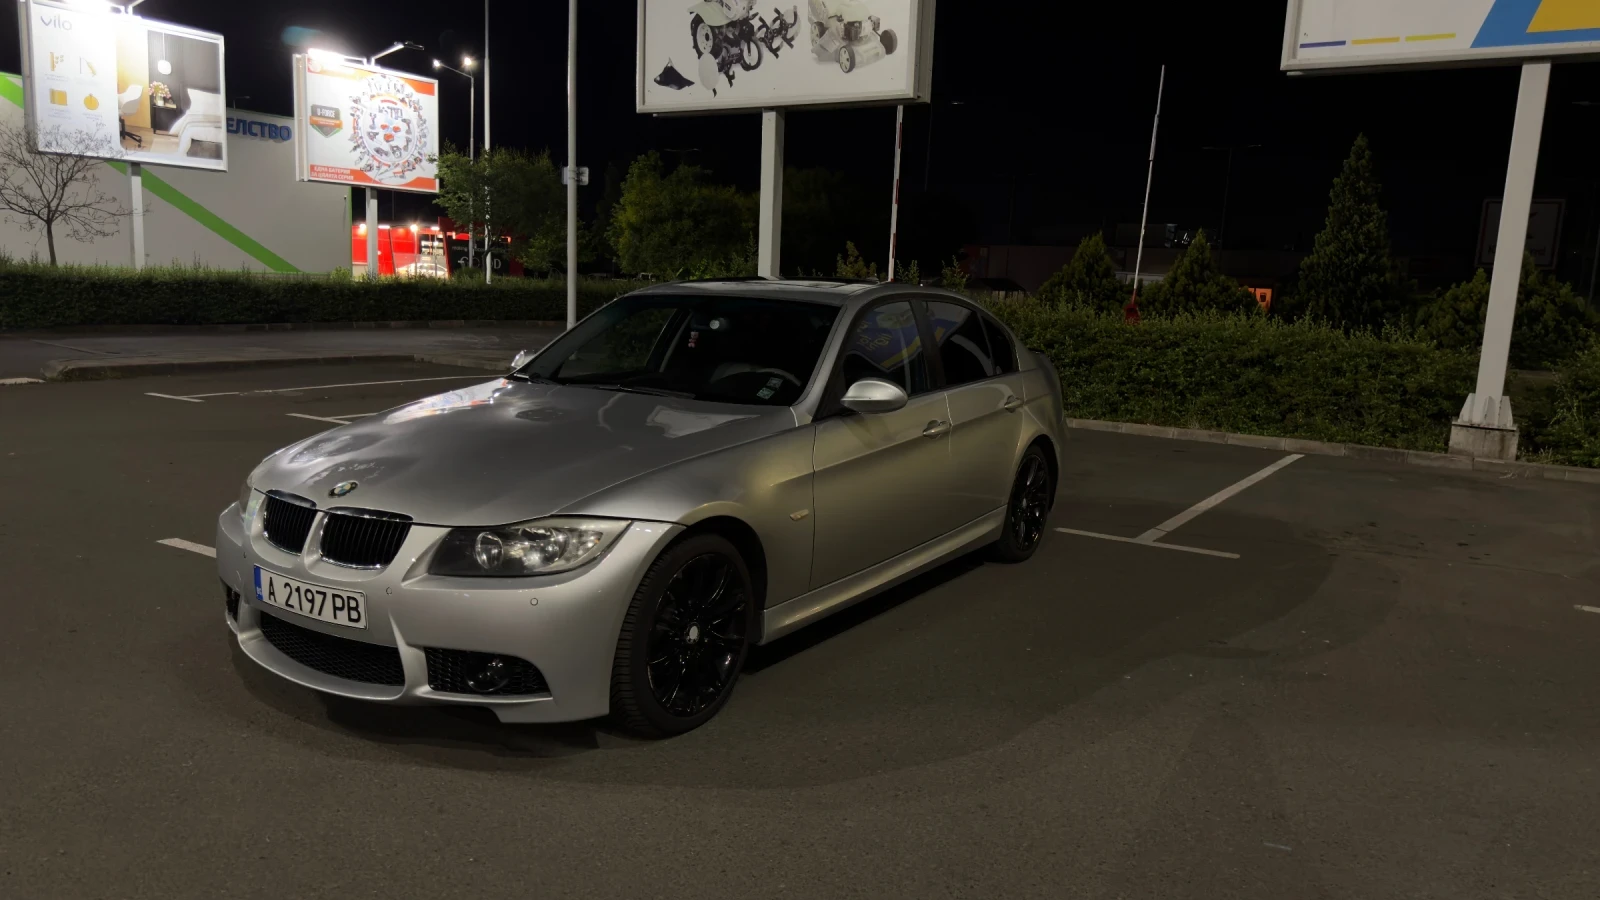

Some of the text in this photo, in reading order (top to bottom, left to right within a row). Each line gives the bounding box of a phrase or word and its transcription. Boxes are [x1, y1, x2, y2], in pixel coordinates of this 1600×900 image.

[40, 14, 72, 31] vilo
[268, 576, 361, 623] A 2197 PB
